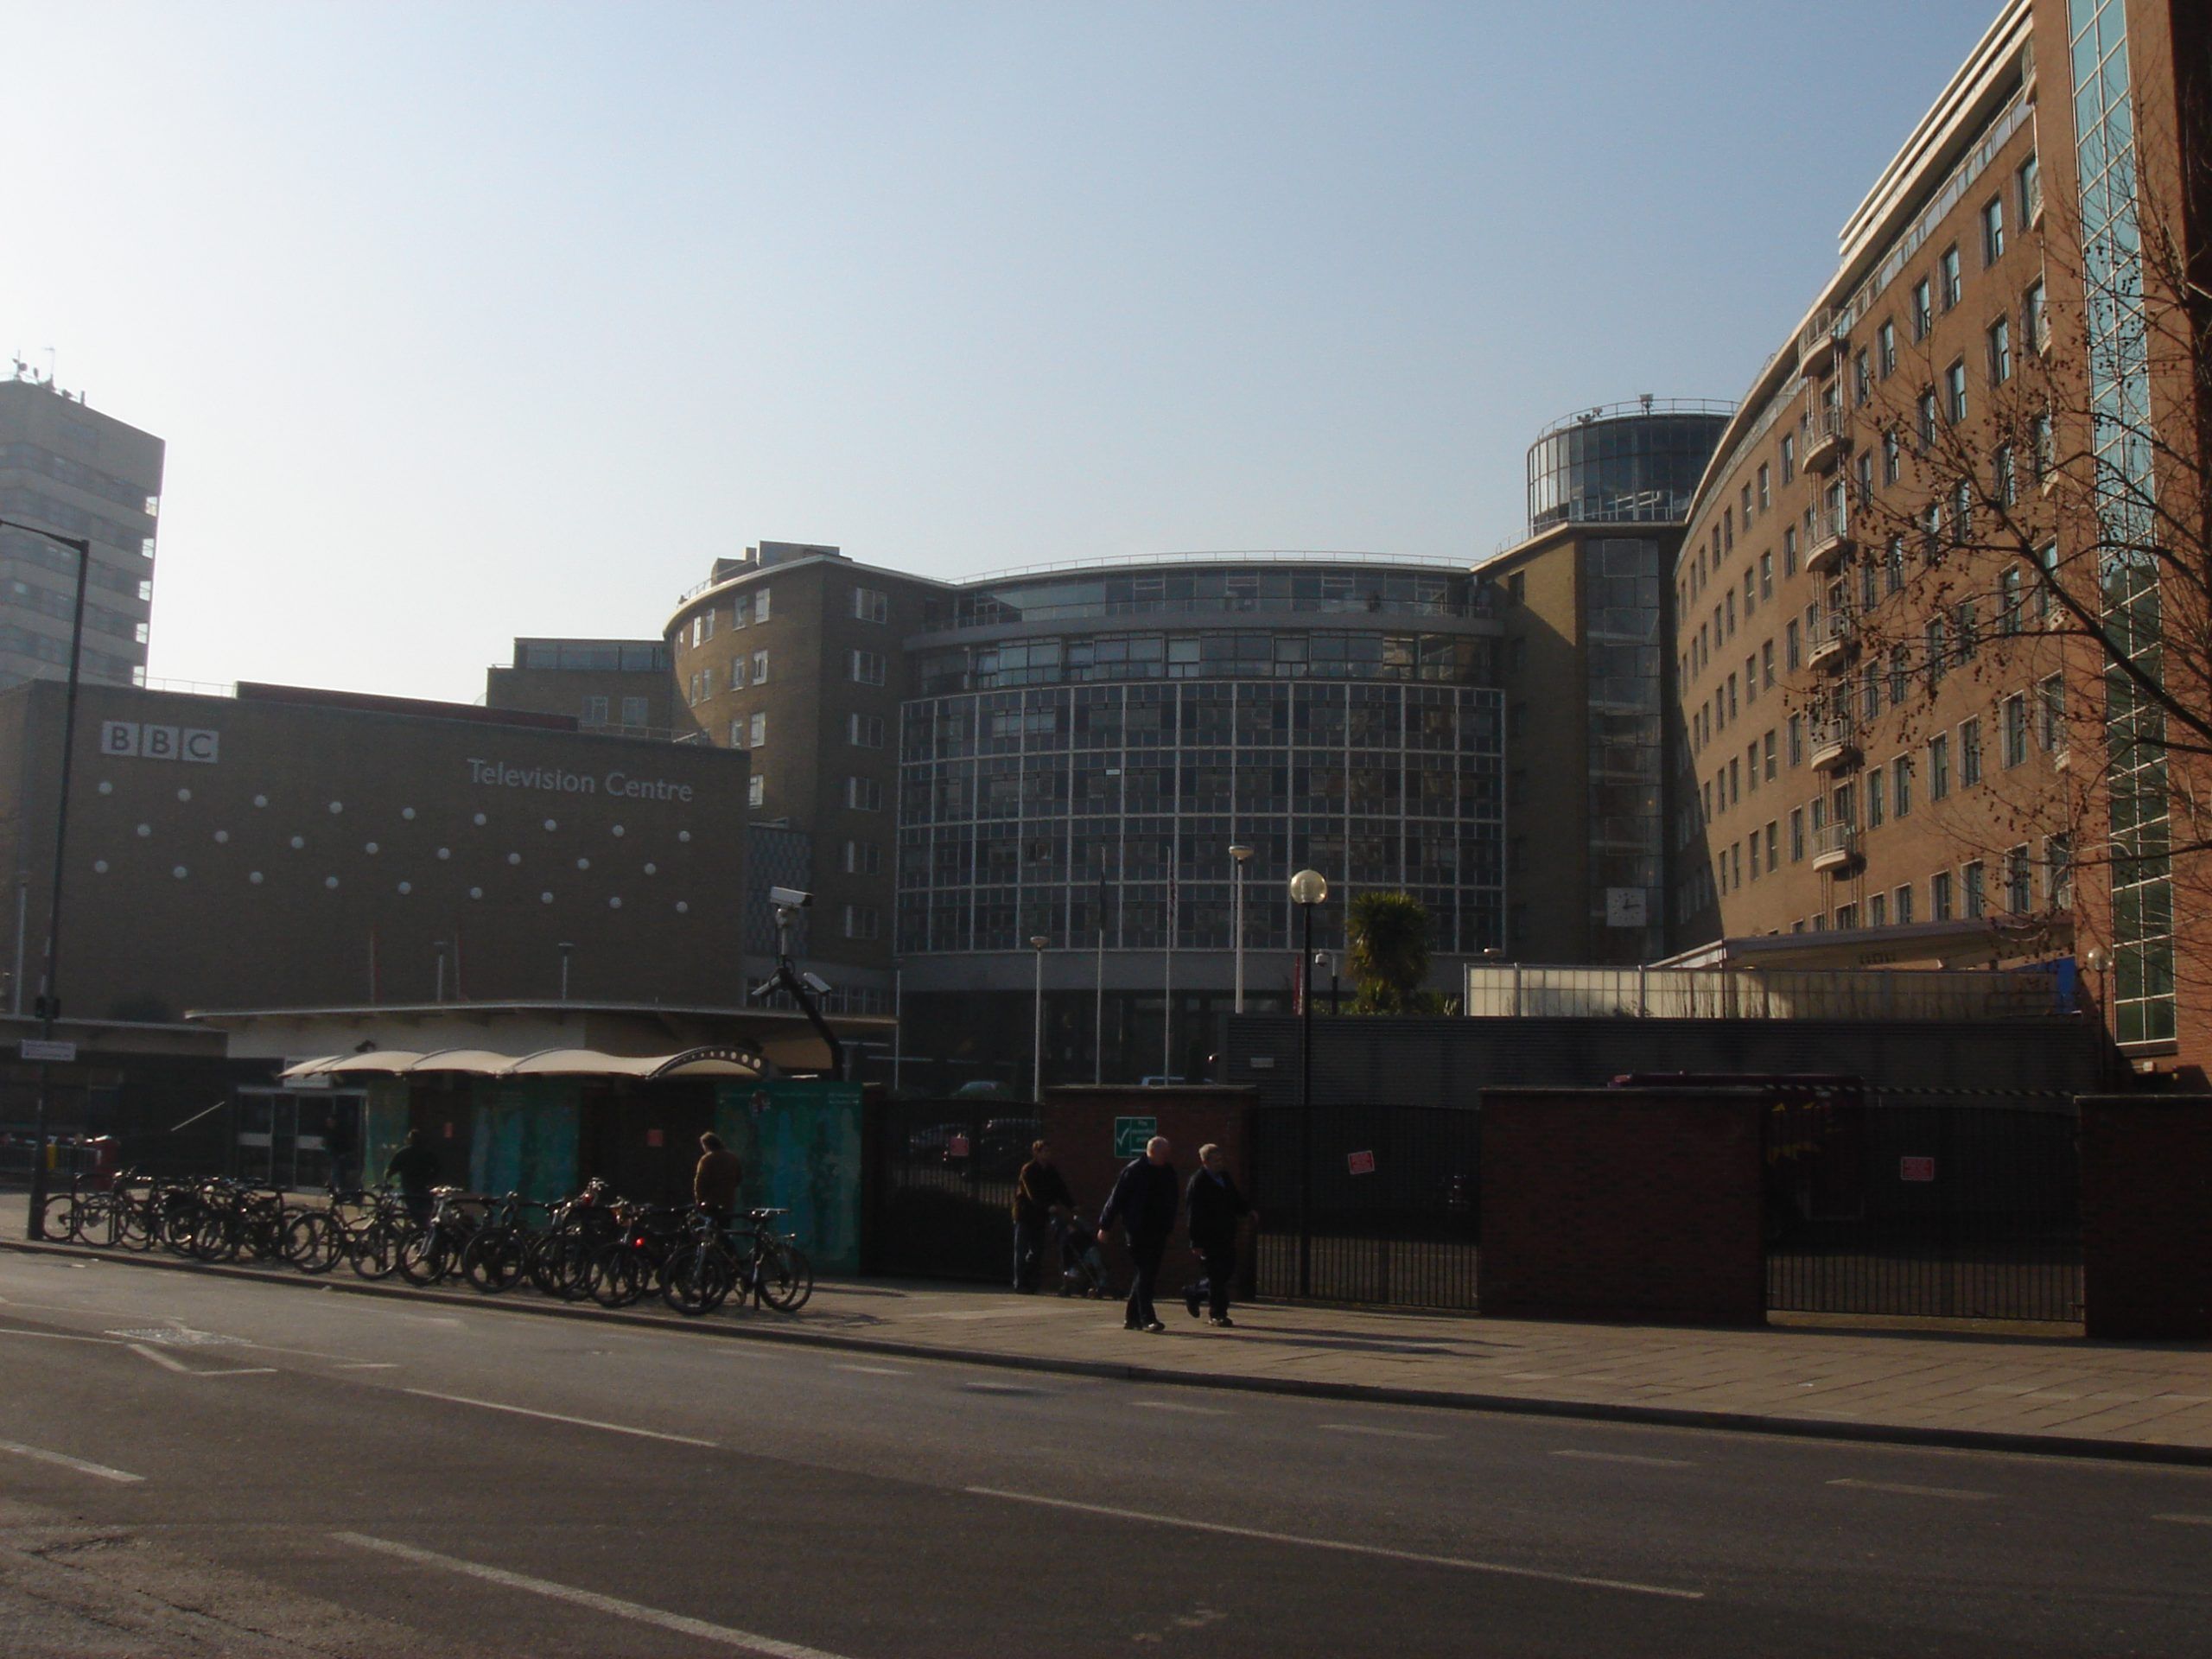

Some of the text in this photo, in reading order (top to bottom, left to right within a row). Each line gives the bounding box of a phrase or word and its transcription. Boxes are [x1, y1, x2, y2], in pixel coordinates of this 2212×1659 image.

[111, 726, 212, 758] BBC
[467, 758, 692, 802] Television Centre
